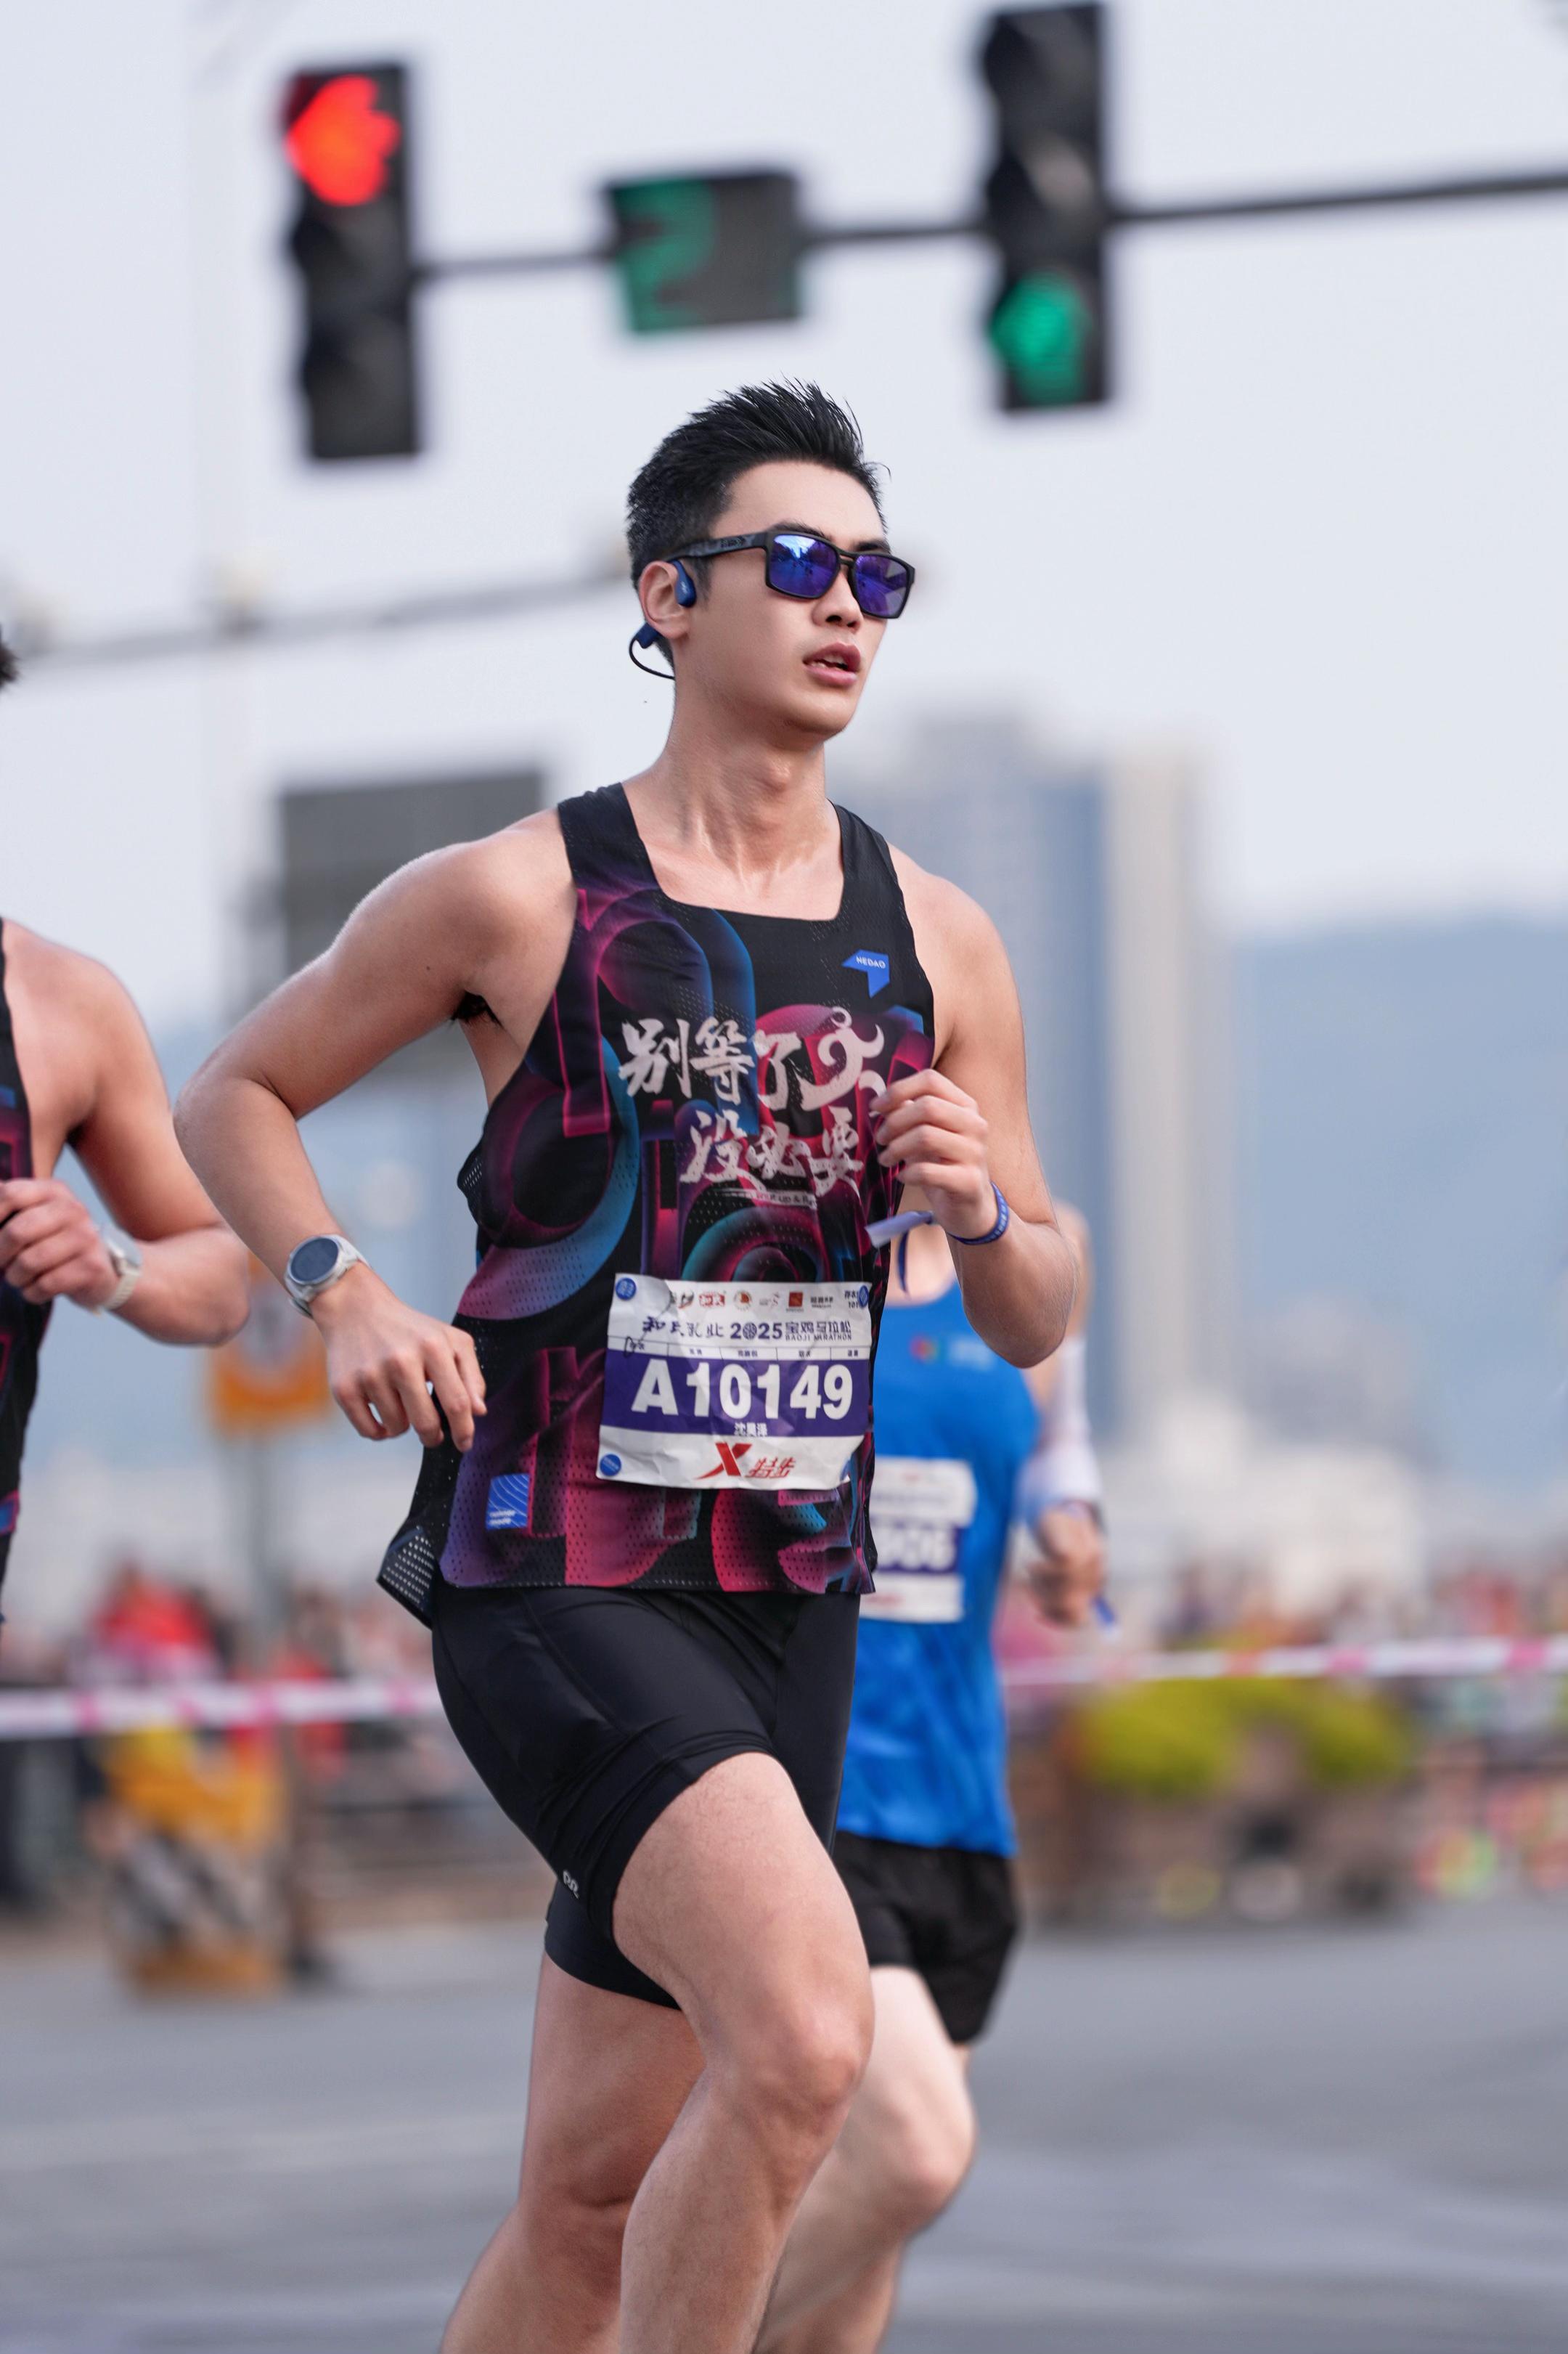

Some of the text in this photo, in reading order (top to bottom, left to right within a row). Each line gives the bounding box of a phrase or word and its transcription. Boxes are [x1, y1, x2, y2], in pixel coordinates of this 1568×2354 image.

[618, 1017, 801, 1111] 别等了
[730, 1322, 783, 1340] 2025
[785, 1320, 852, 1335] 宝鸡马拉松
[631, 1359, 853, 1421] A10149
[744, 1457, 797, 1478] 特步
